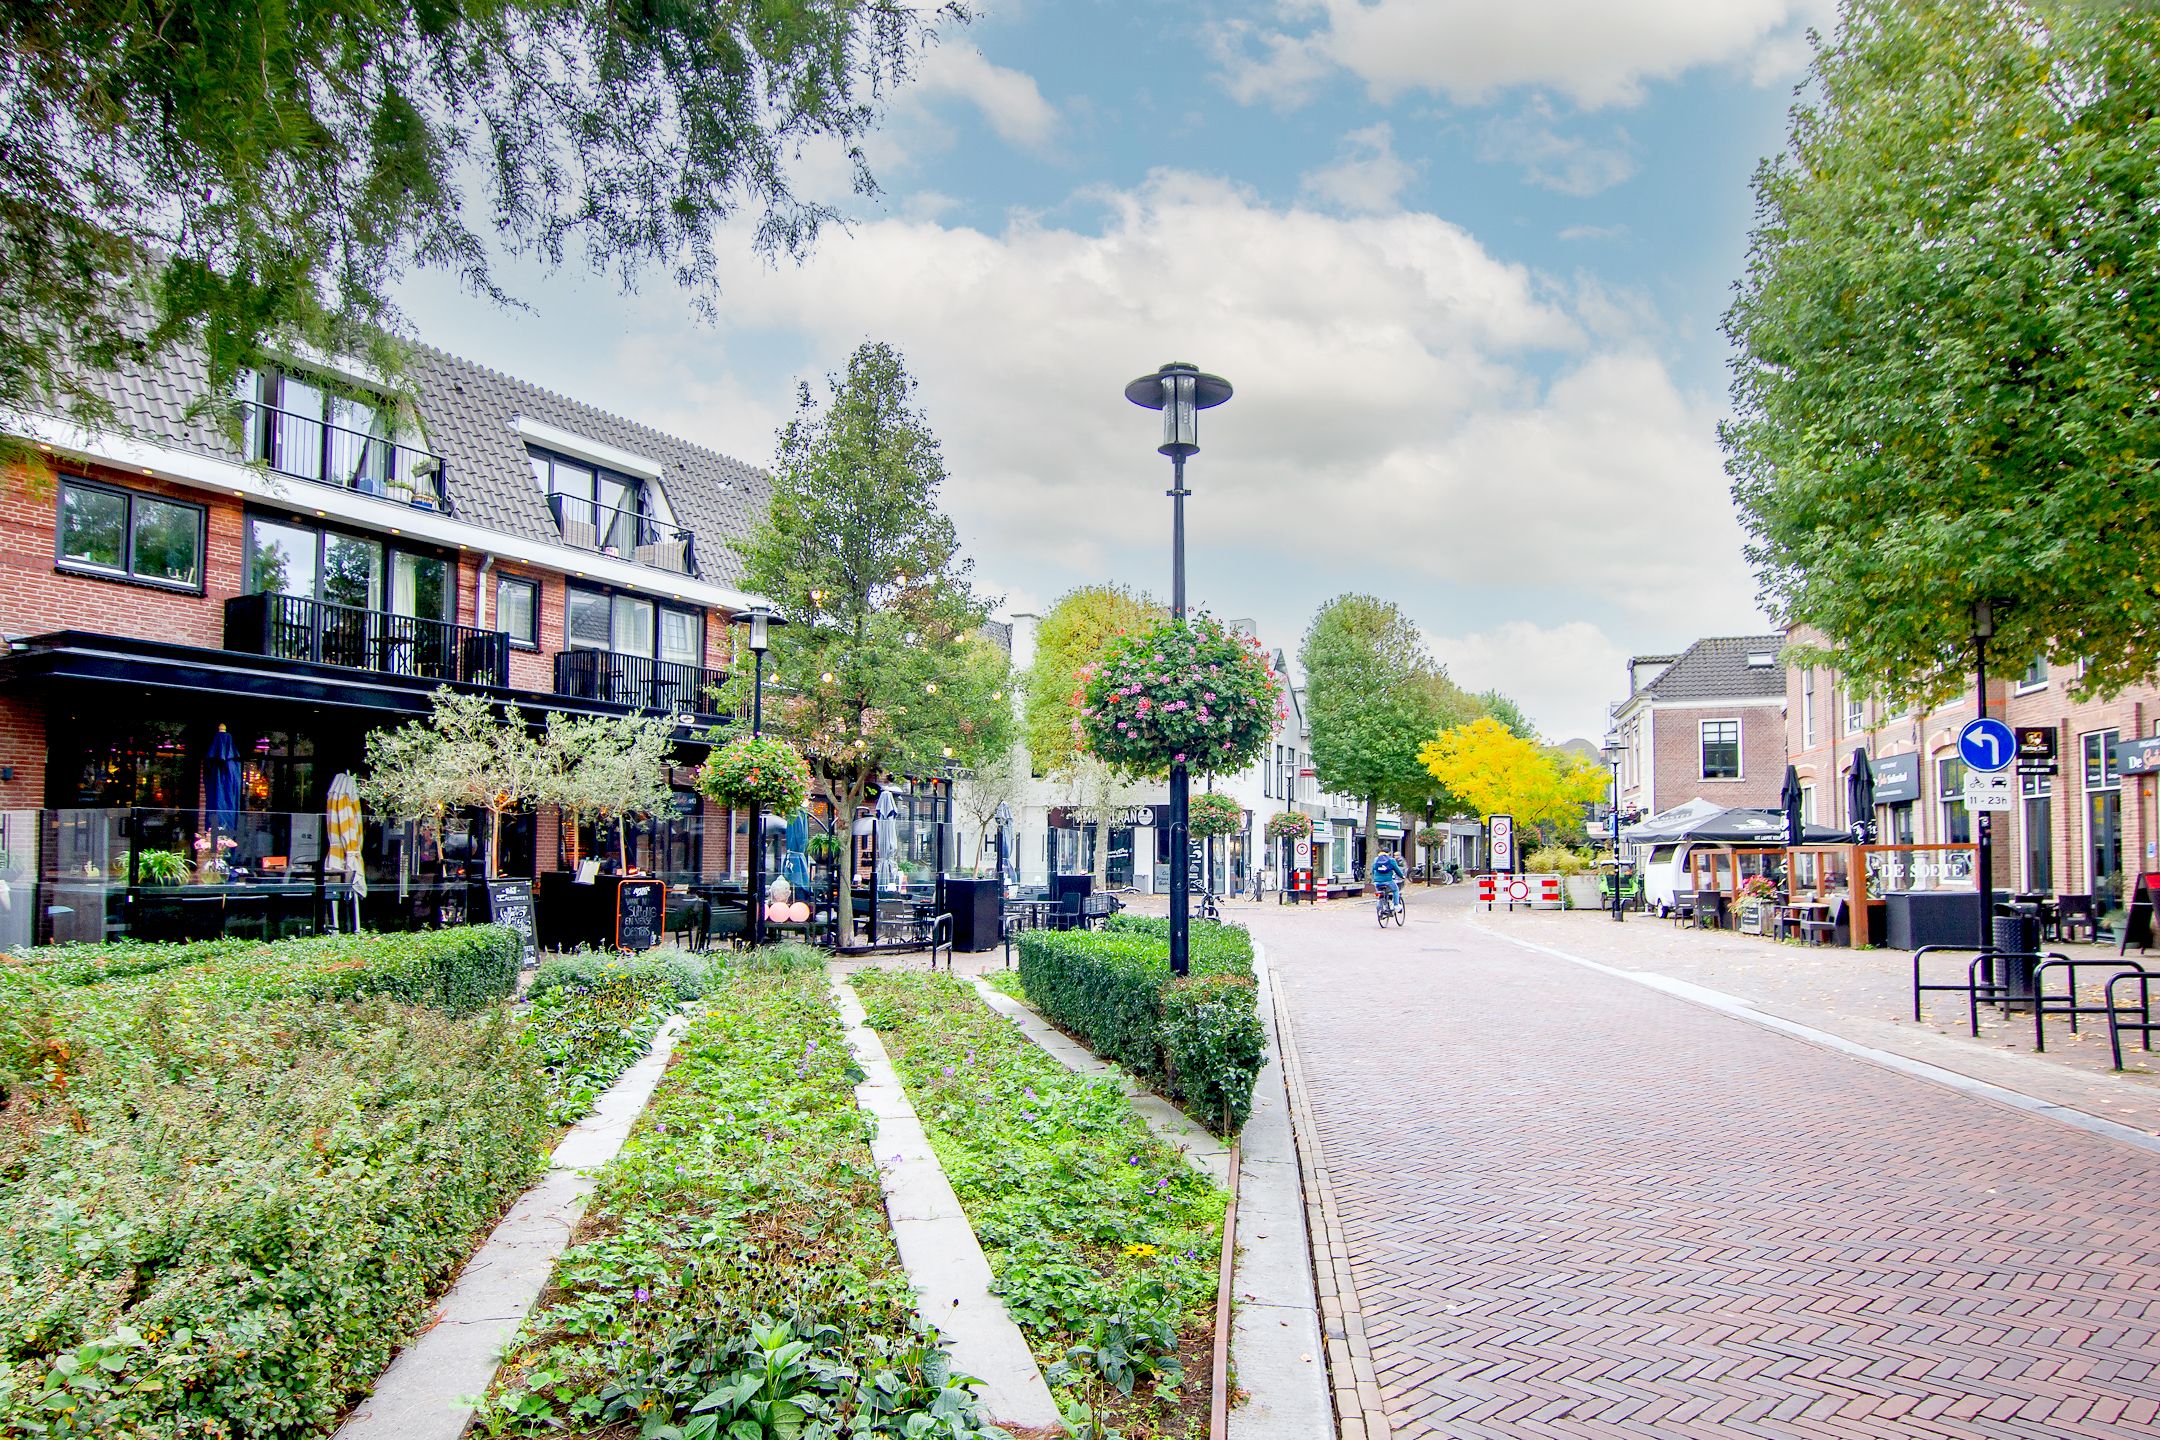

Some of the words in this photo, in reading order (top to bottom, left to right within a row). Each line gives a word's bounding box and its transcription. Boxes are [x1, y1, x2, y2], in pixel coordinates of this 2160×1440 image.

[2128, 756, 2143, 769] De
[1970, 796, 1977, 804] 11
[1988, 796, 2007, 805] 23h
[1881, 863, 1905, 878] DE
[1909, 863, 1963, 878] SOETE
